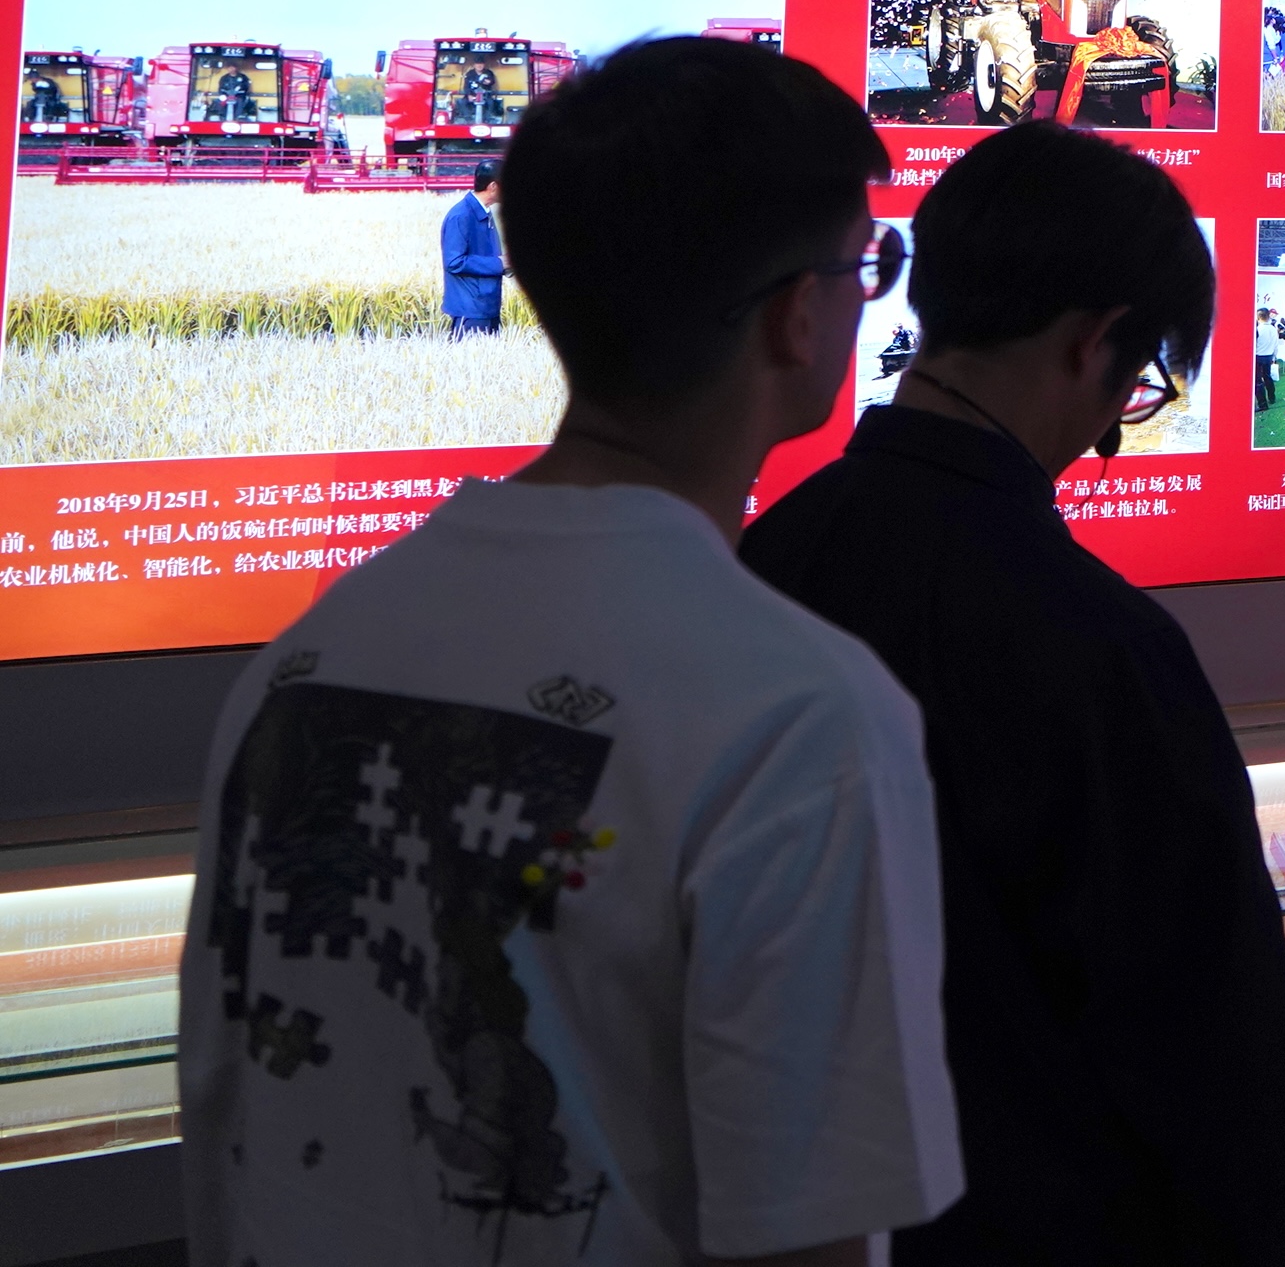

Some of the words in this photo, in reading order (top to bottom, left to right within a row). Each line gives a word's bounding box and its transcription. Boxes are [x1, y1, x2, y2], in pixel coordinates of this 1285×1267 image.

[905, 145, 972, 164] 2010年9
[867, 168, 946, 187] 力换挡
[1054, 499, 1177, 520] 海作业拖拉机。
[1, 511, 430, 554] 前，他说，中国人的饭碗任何时候都要牢
